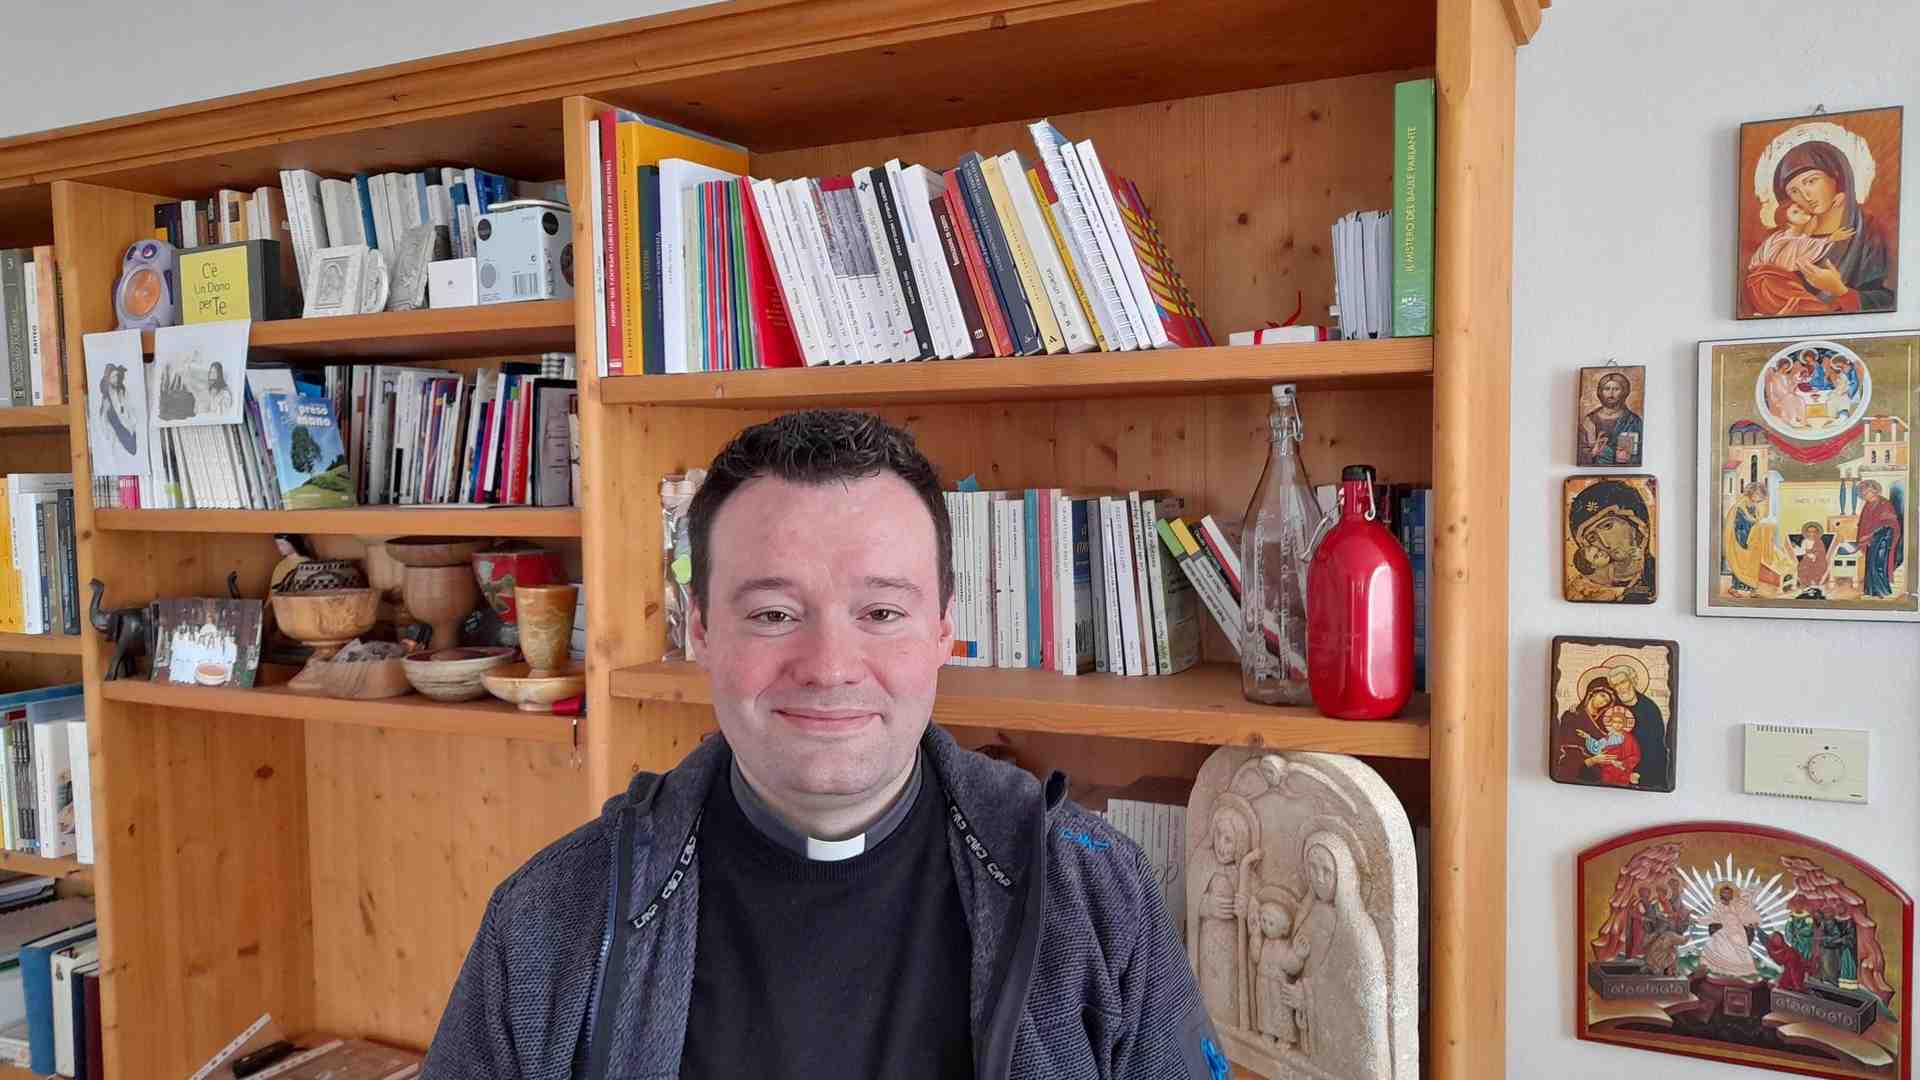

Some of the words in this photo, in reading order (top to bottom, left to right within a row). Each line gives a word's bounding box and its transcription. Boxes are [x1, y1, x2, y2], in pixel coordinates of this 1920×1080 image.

[1407, 126, 1416, 171] PARLANTE
[1407, 175, 1415, 201] BAULE
[1406, 203, 1415, 219] DEL
[1405, 222, 1415, 262] MISTERO
[212, 296, 228, 316] Te
[298, 404, 329, 416] preso
[296, 416, 331, 427] mano
